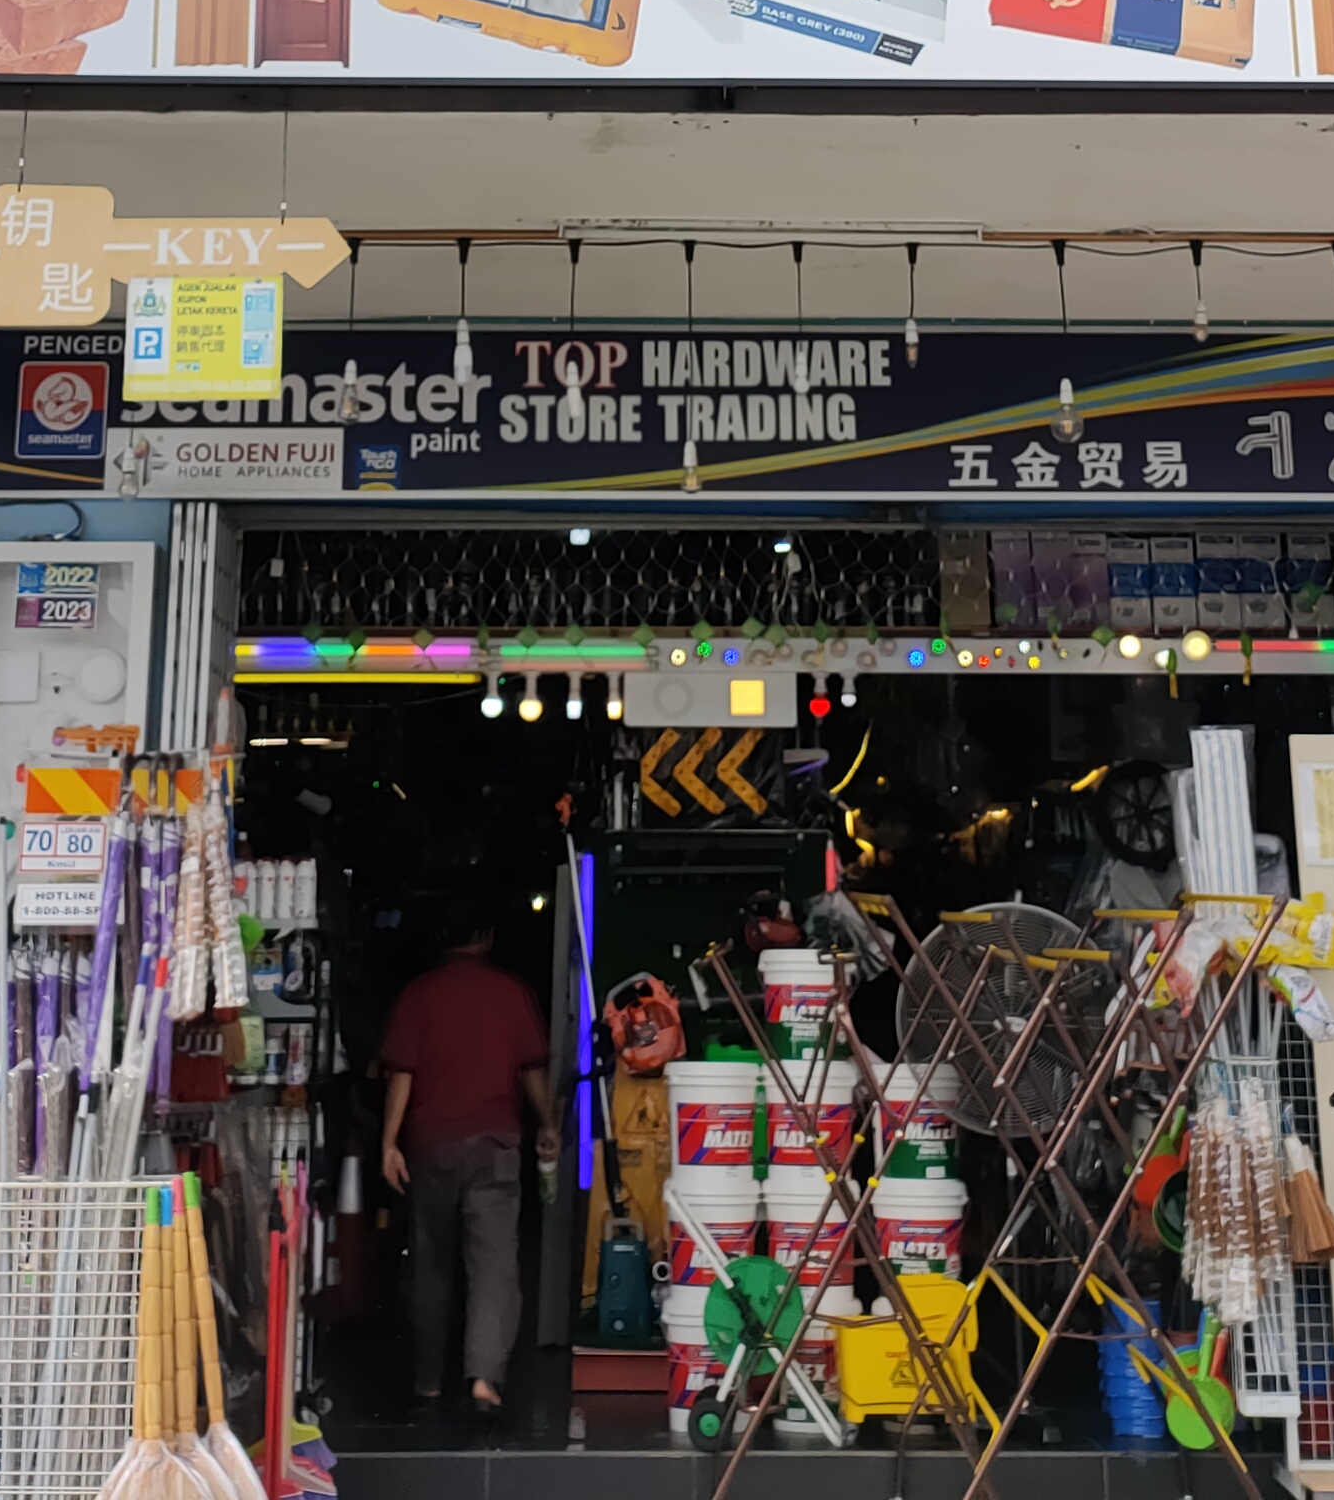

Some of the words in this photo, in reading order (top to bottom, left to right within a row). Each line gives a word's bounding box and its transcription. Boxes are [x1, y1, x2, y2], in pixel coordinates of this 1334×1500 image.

[762, 5, 794, 23] BASE
[796, 15, 832, 33] GREY
[154, 227, 275, 266] KEY
[177, 295, 207, 304] KUPON
[177, 307, 204, 315] LETAK
[515, 341, 628, 388] TOP
[642, 341, 891, 387] HARDWARE
[499, 395, 641, 443] STORE
[658, 395, 857, 442] TRADING
[27, 432, 93, 445] seamaster
[409, 427, 481, 459] paint
[176, 442, 278, 463] GOLDEN
[286, 442, 335, 463] FUJI
[177, 466, 222, 478] HOME
[236, 465, 331, 478] APPLIANCES
[948, 440, 1189, 489] 五金贸易
[45, 566, 94, 586] 2022
[42, 600, 91, 621] 2023
[26, 829, 52, 853] 70
[67, 834, 93, 854] 80
[36, 891, 96, 901] HOTLINE
